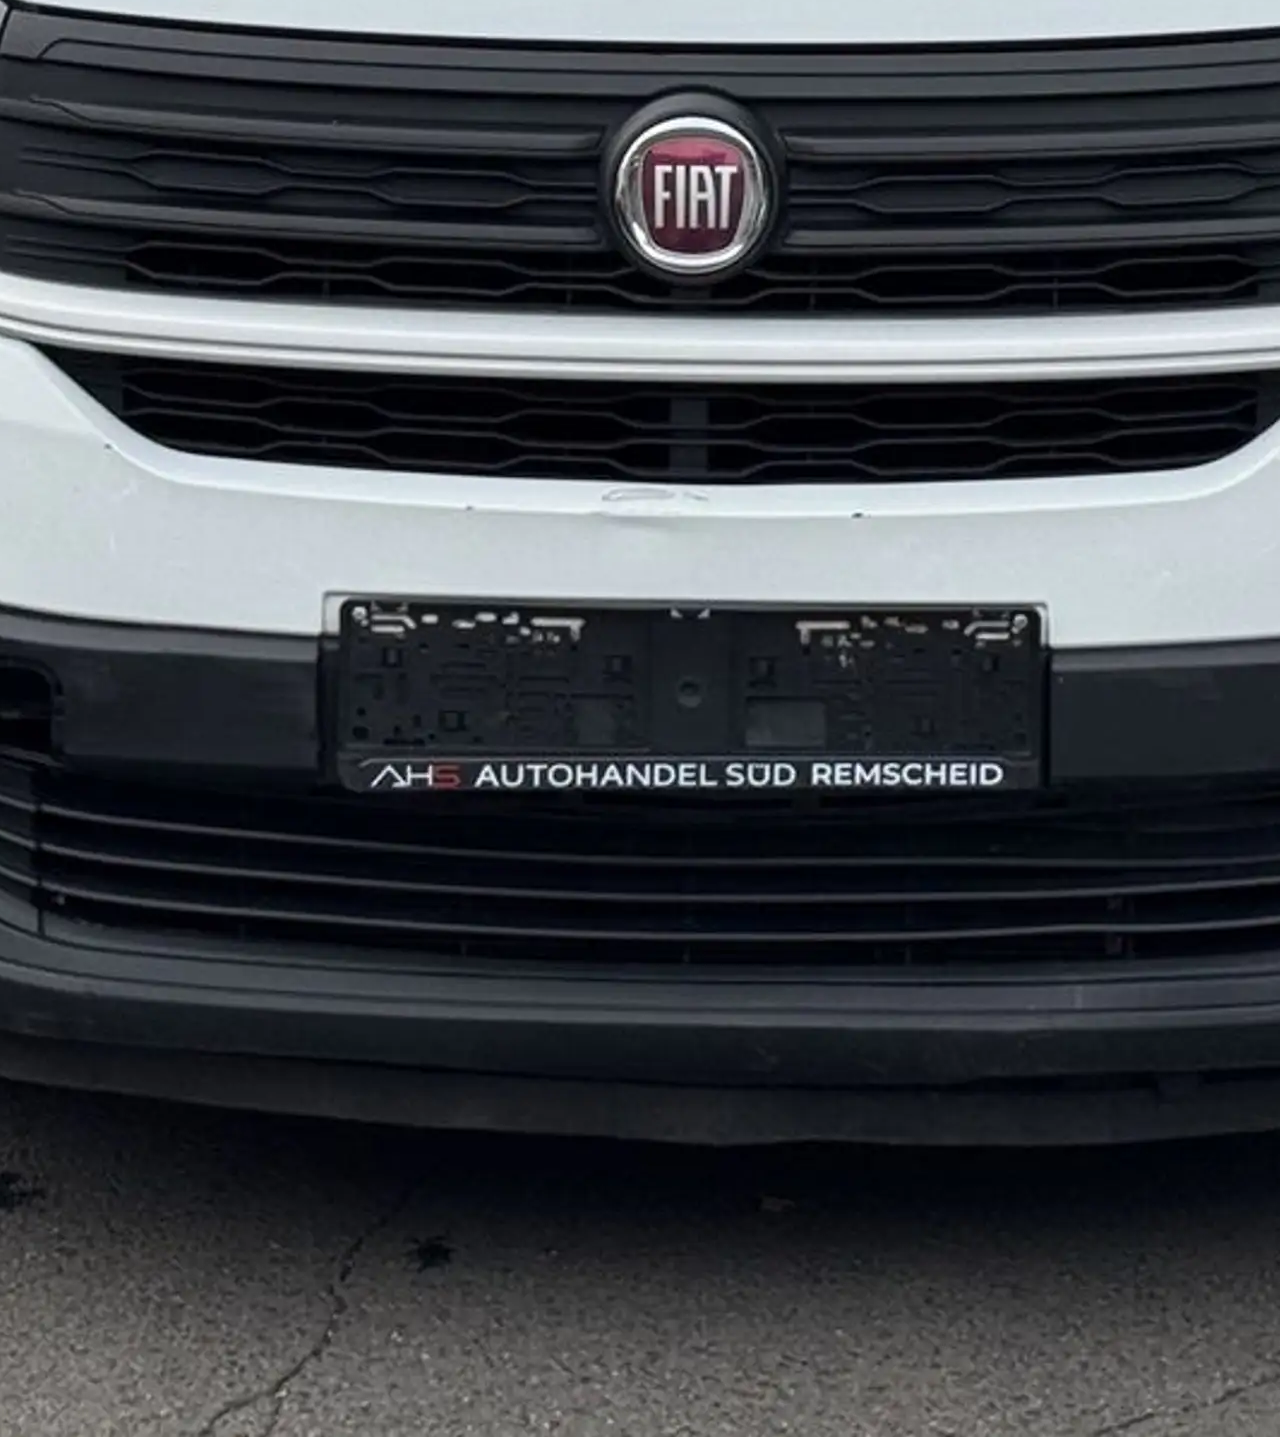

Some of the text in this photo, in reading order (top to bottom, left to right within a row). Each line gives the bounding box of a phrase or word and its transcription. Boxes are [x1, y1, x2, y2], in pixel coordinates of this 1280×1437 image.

[653, 164, 739, 230] FIAT
[370, 760, 1004, 789] AHS AUTOHANDEL SÜD REMSCHEID
